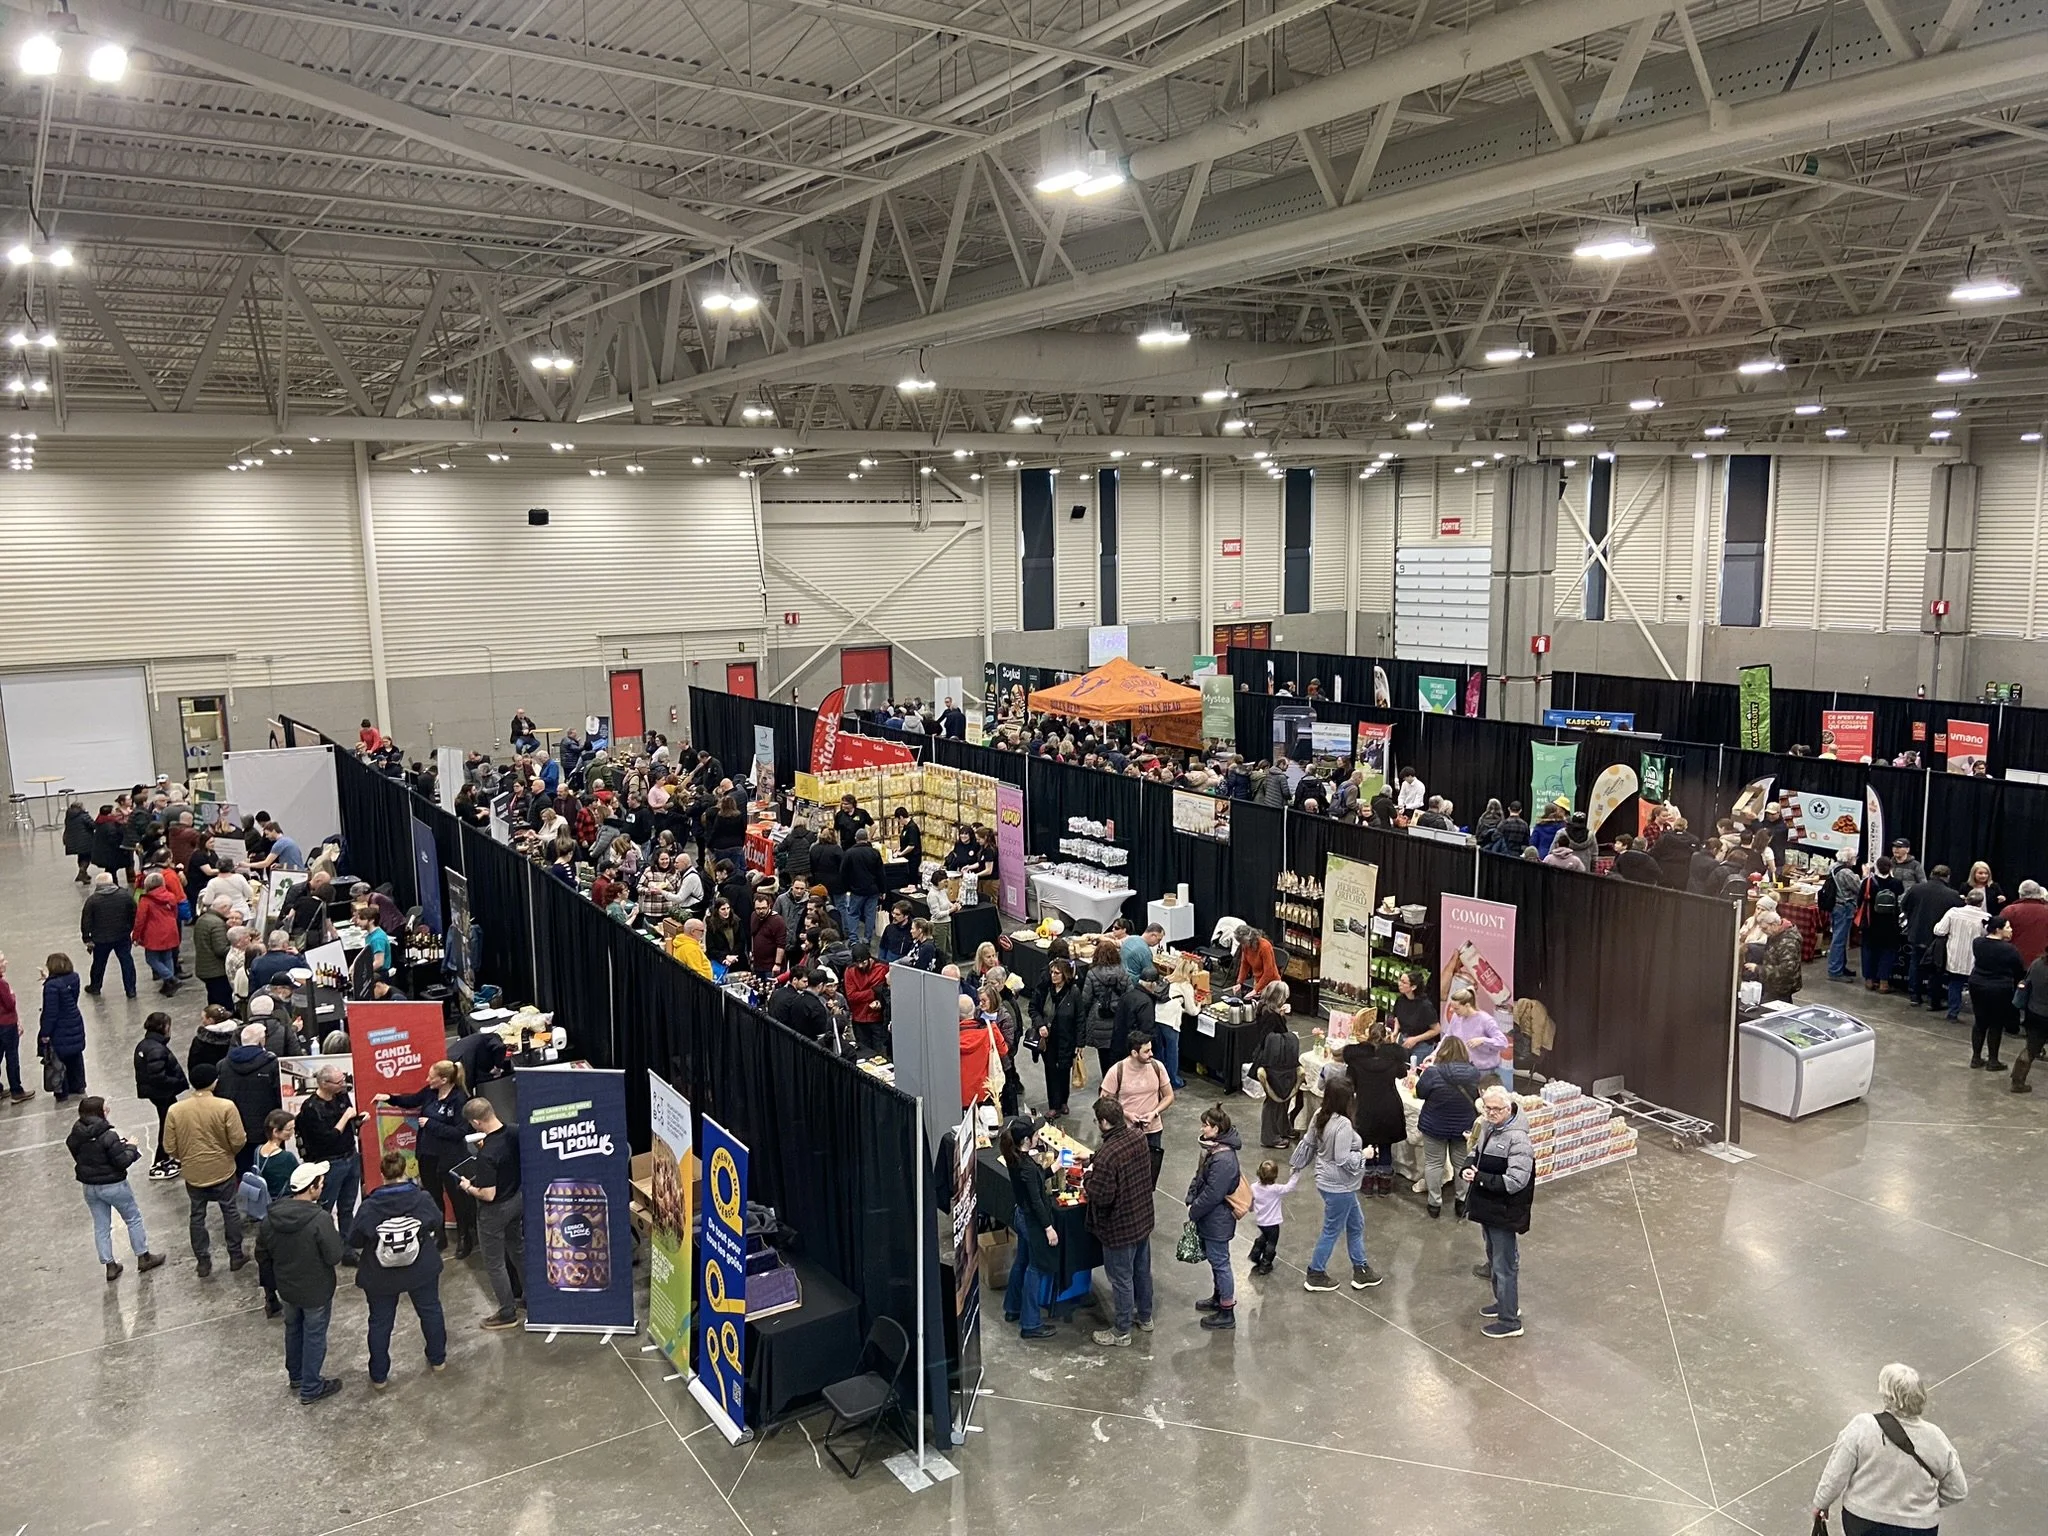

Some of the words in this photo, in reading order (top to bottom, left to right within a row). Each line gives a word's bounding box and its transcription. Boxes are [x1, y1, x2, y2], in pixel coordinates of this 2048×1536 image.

[1442, 522, 1460, 530] SORTIE
[1224, 542, 1240, 552] SORTIE
[1400, 564, 1405, 573] 9
[1162, 700, 1181, 712] HEAD
[1203, 694, 1230, 704] Mystea
[1336, 882, 1366, 897] HERBES
[1335, 890, 1367, 906] ORFORD
[1452, 908, 1505, 929] COMONT
[375, 1044, 411, 1060] CANDI
[398, 1053, 421, 1066] POW
[548, 1120, 596, 1140] SNACK
[566, 1134, 598, 1151] POW
[712, 1152, 734, 1176] ALIMENTS
[714, 1193, 735, 1219] QUÉBEC
[716, 1227, 727, 1243] tout
[727, 1237, 741, 1255] pour
[706, 1232, 717, 1250] tous
[726, 1252, 742, 1273] goûts
